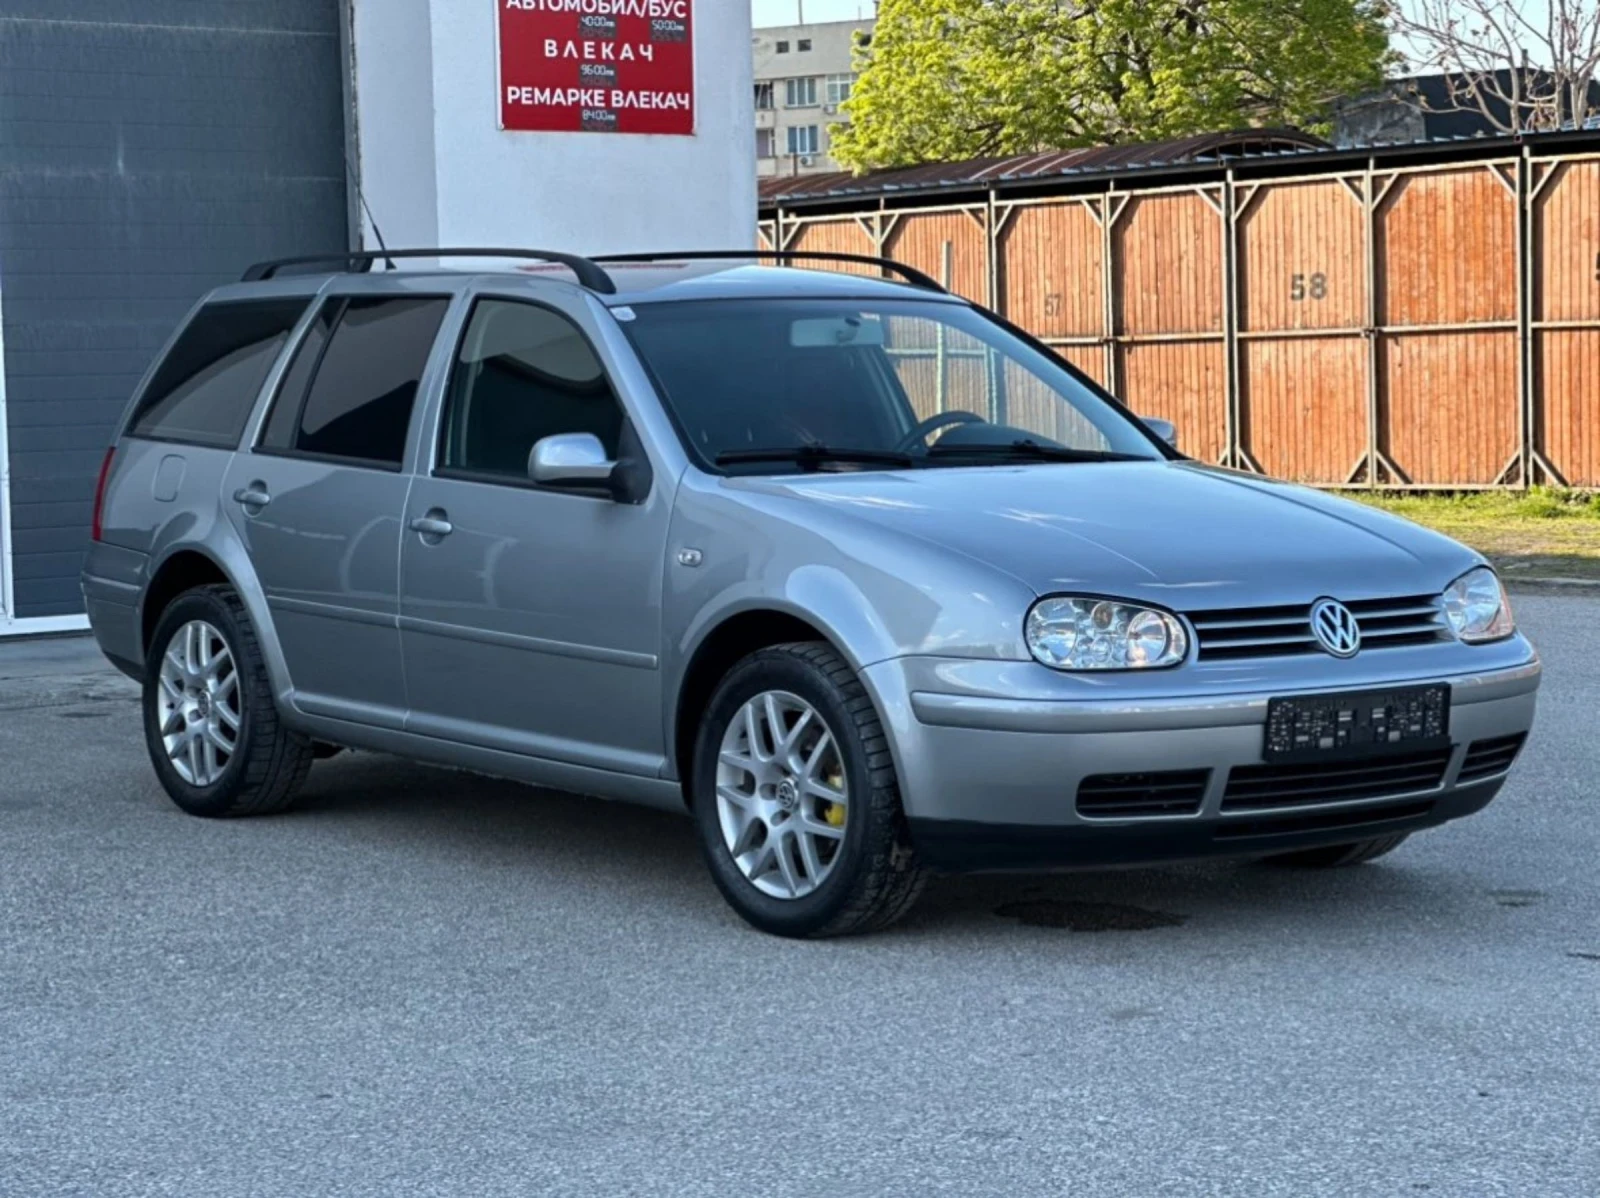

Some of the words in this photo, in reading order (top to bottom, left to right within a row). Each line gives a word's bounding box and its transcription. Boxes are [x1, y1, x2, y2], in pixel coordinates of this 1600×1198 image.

[544, 39, 653, 61] ВЛЕКАЧ
[507, 86, 605, 107] РЕМАРКЕ
[611, 89, 690, 110] ВЛЕКАЧ
[1291, 272, 1328, 301] 58
[1044, 293, 1061, 317] 57
